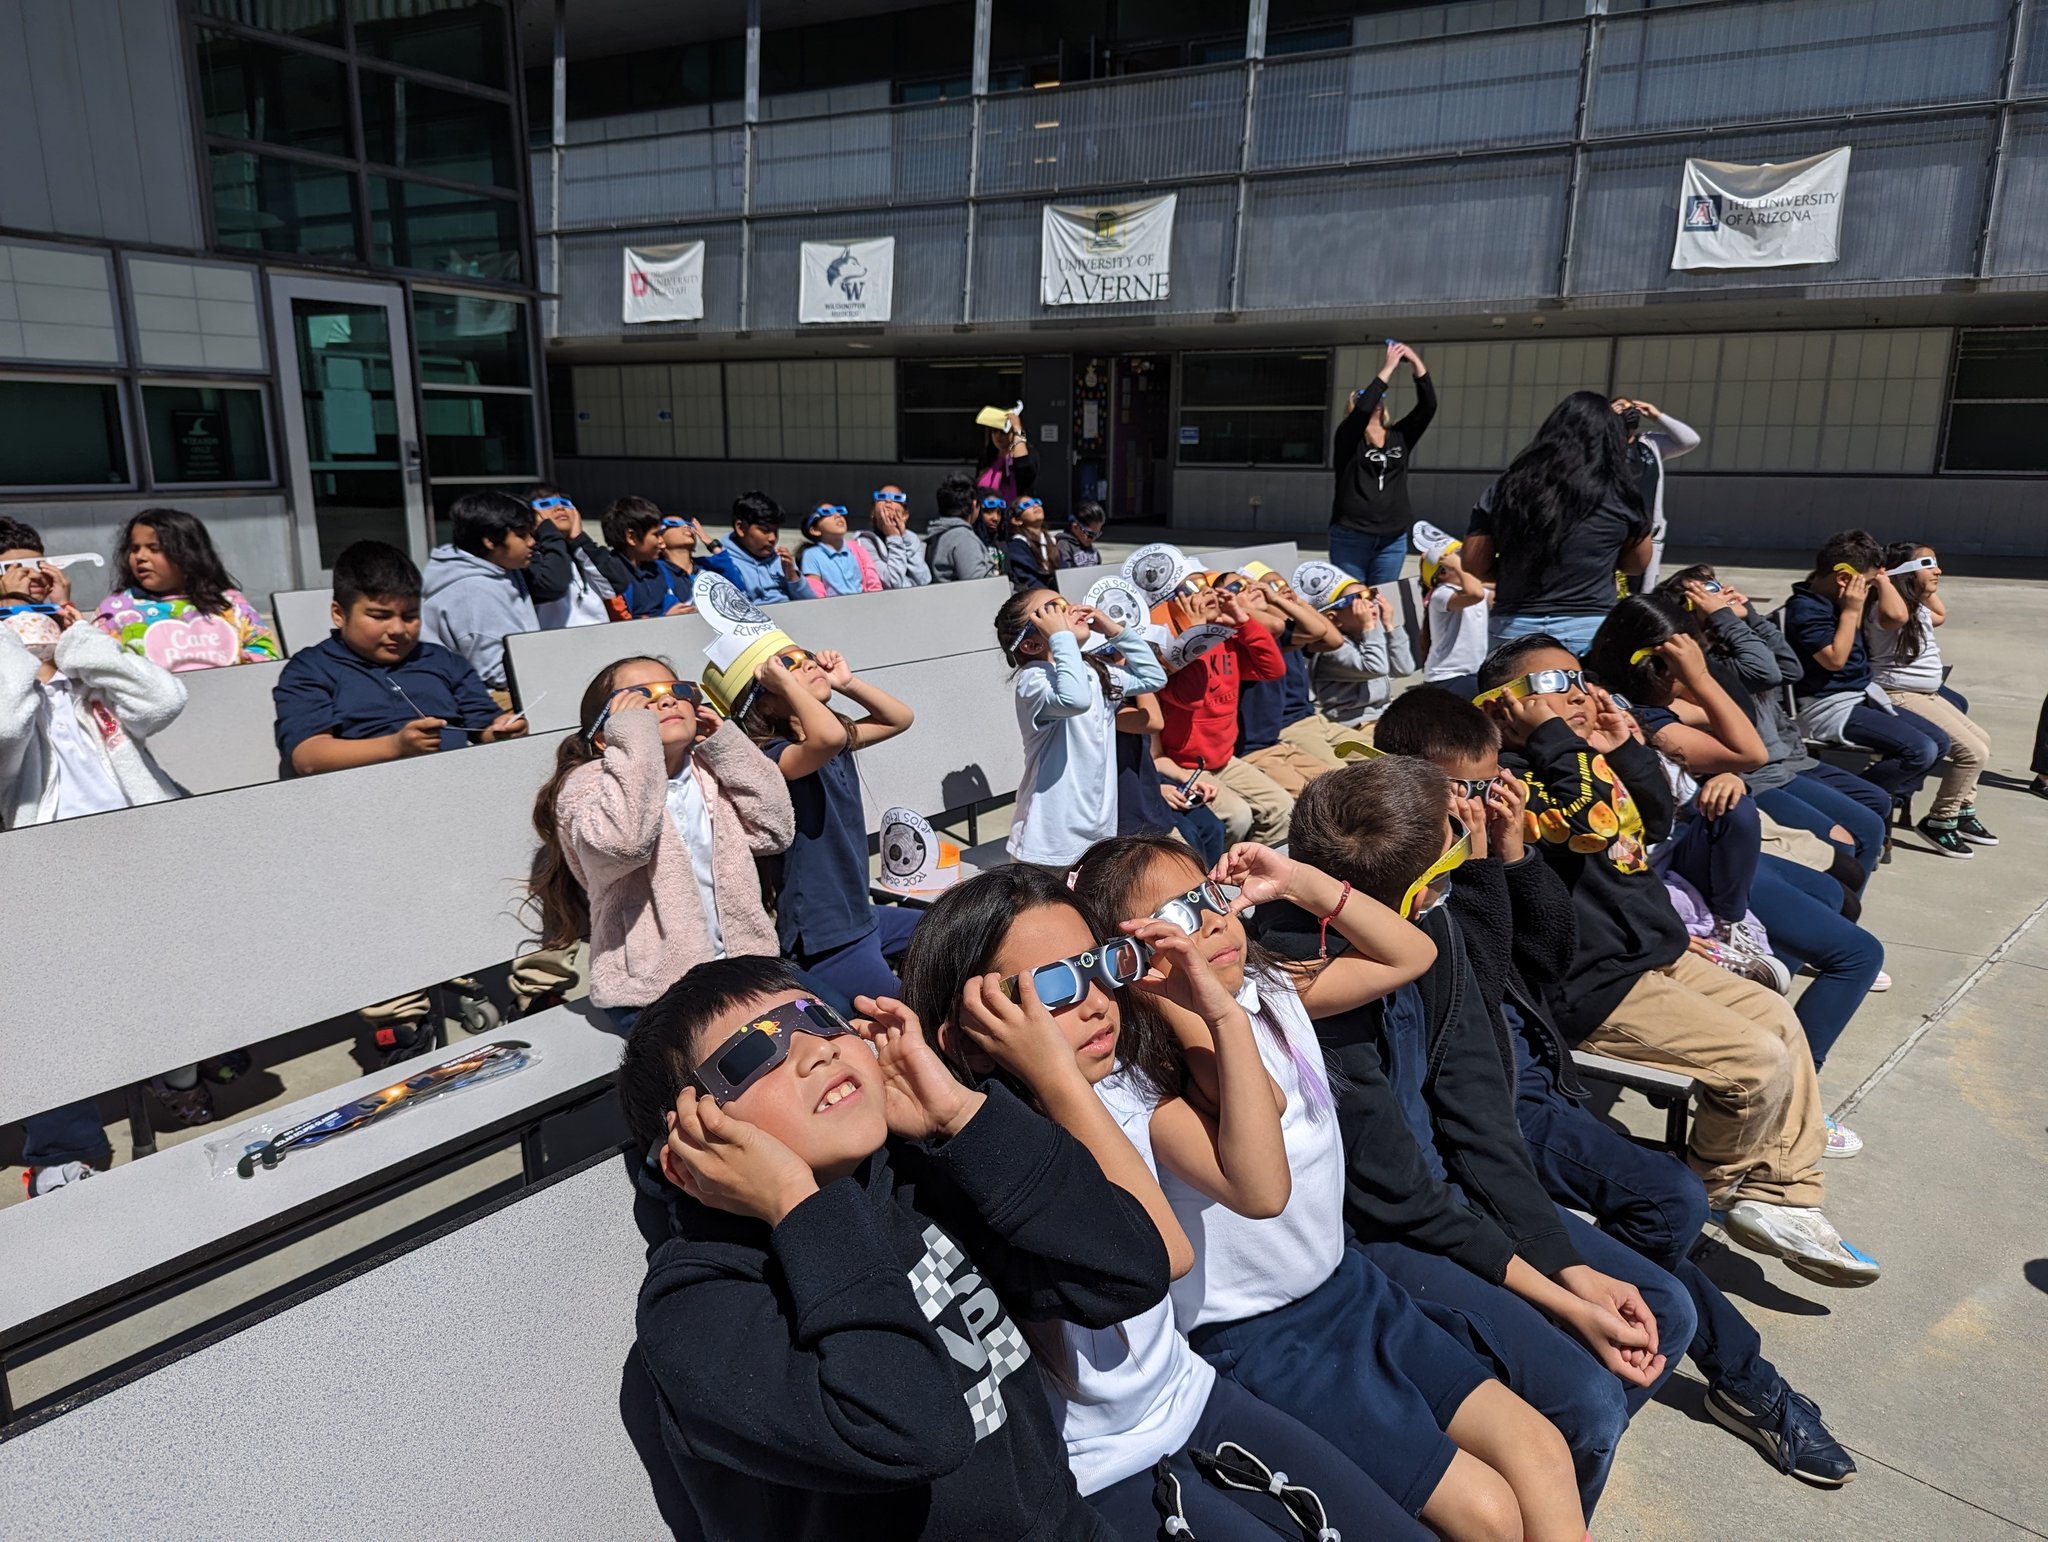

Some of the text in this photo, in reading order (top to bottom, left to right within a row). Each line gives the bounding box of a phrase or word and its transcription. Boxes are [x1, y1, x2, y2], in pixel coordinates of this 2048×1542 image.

[1728, 192, 1839, 211] THE UNIVERSITY
[1725, 208, 1812, 226] OF ARIZONA
[1058, 253, 1154, 272] UNIVERSITY OF
[845, 281, 866, 301] W
[1041, 272, 1170, 304] LA VERNE
[170, 629, 220, 650] Care
[1210, 654, 1233, 676] KE
[903, 871, 928, 887] 2024
